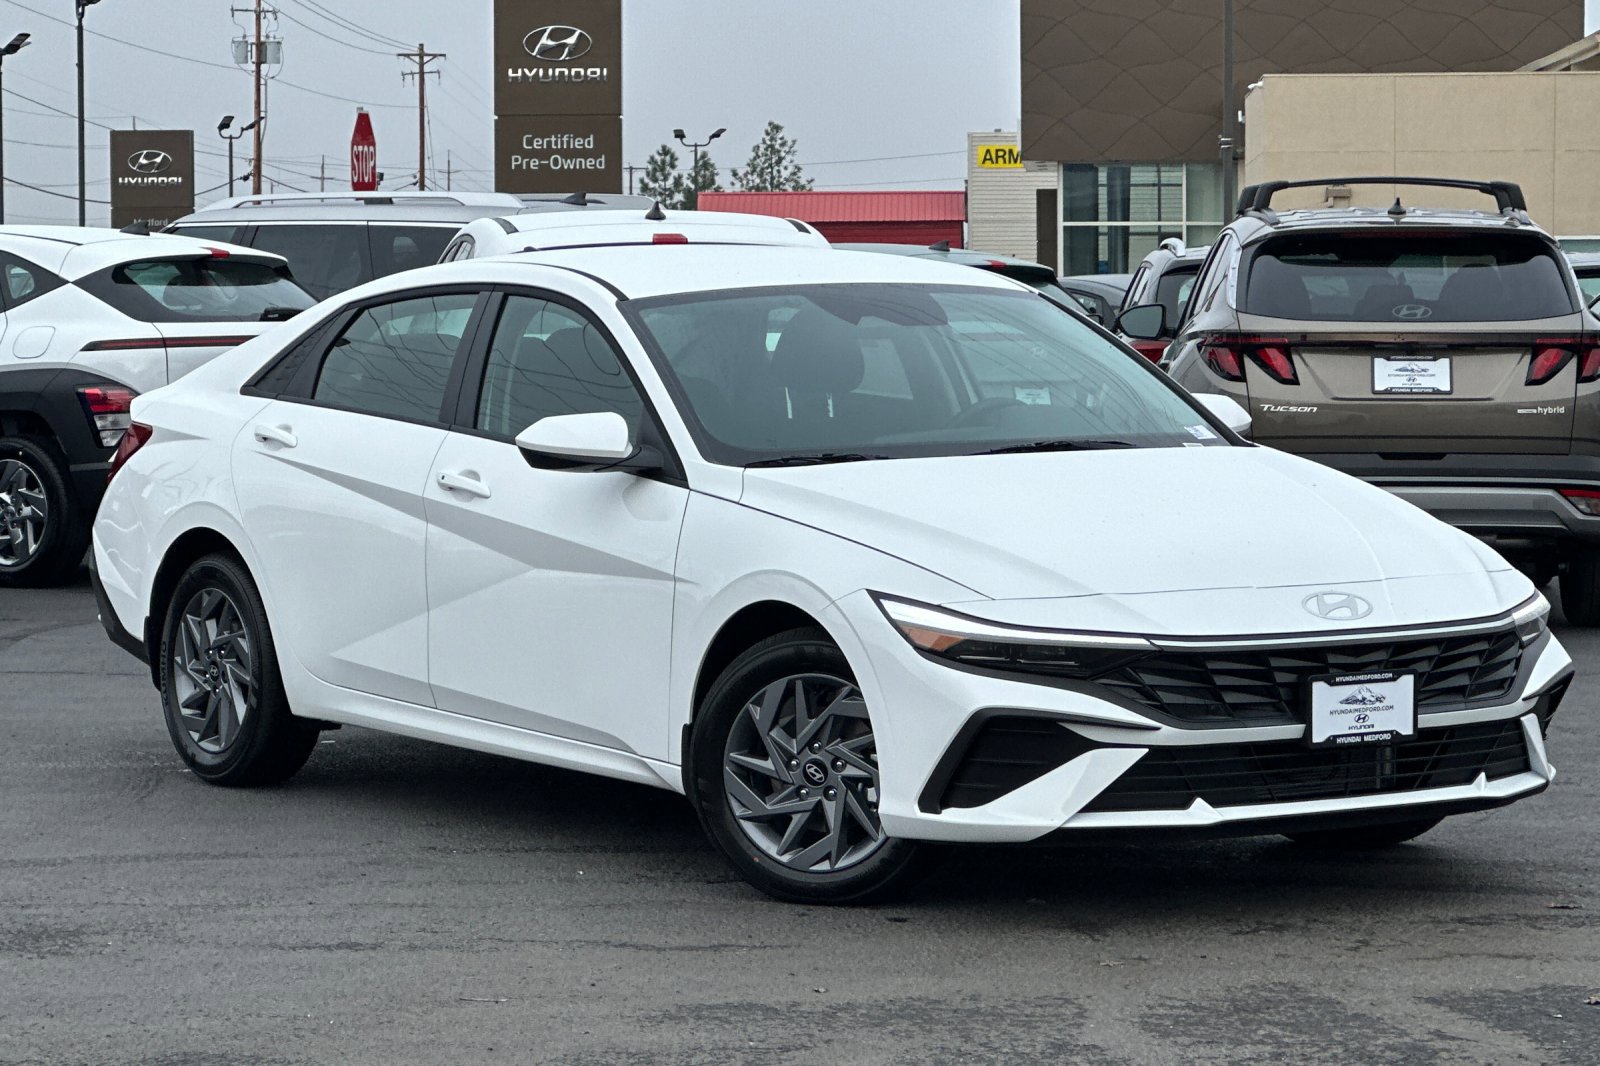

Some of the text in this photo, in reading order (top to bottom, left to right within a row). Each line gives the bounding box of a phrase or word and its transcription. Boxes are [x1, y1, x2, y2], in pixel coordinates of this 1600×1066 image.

[508, 67, 608, 82] HYUNDAI
[522, 134, 594, 149] Certified
[352, 145, 375, 183] STOP
[511, 154, 606, 170] Pre-Owned
[118, 176, 183, 186] HYUNDAI
[133, 218, 169, 227] Mdford
[1537, 405, 1565, 415] hybrid
[1335, 672, 1393, 683] HYUNDAIMEDFORD.COM
[1329, 705, 1395, 716] HYUNDAIMEDFORD.COM
[1336, 732, 1392, 744] HYUNDAI MEDFORD
